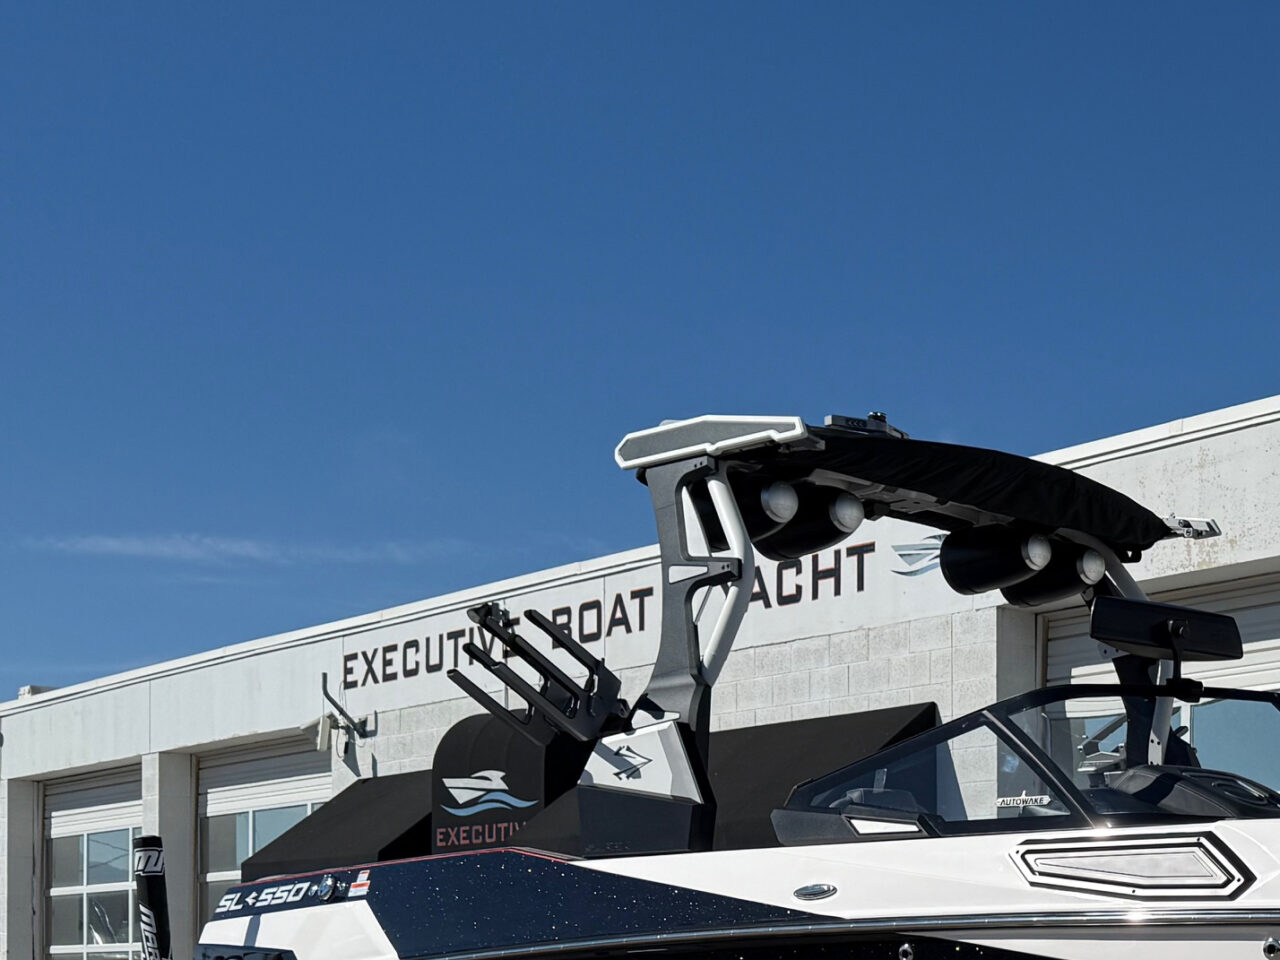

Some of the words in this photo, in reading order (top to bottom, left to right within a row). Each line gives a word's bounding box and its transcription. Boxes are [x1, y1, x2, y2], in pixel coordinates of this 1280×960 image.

[552, 586, 654, 649] BOAT
[721, 541, 875, 609] ACHT
[1000, 796, 1044, 806] AUTOWAKE
